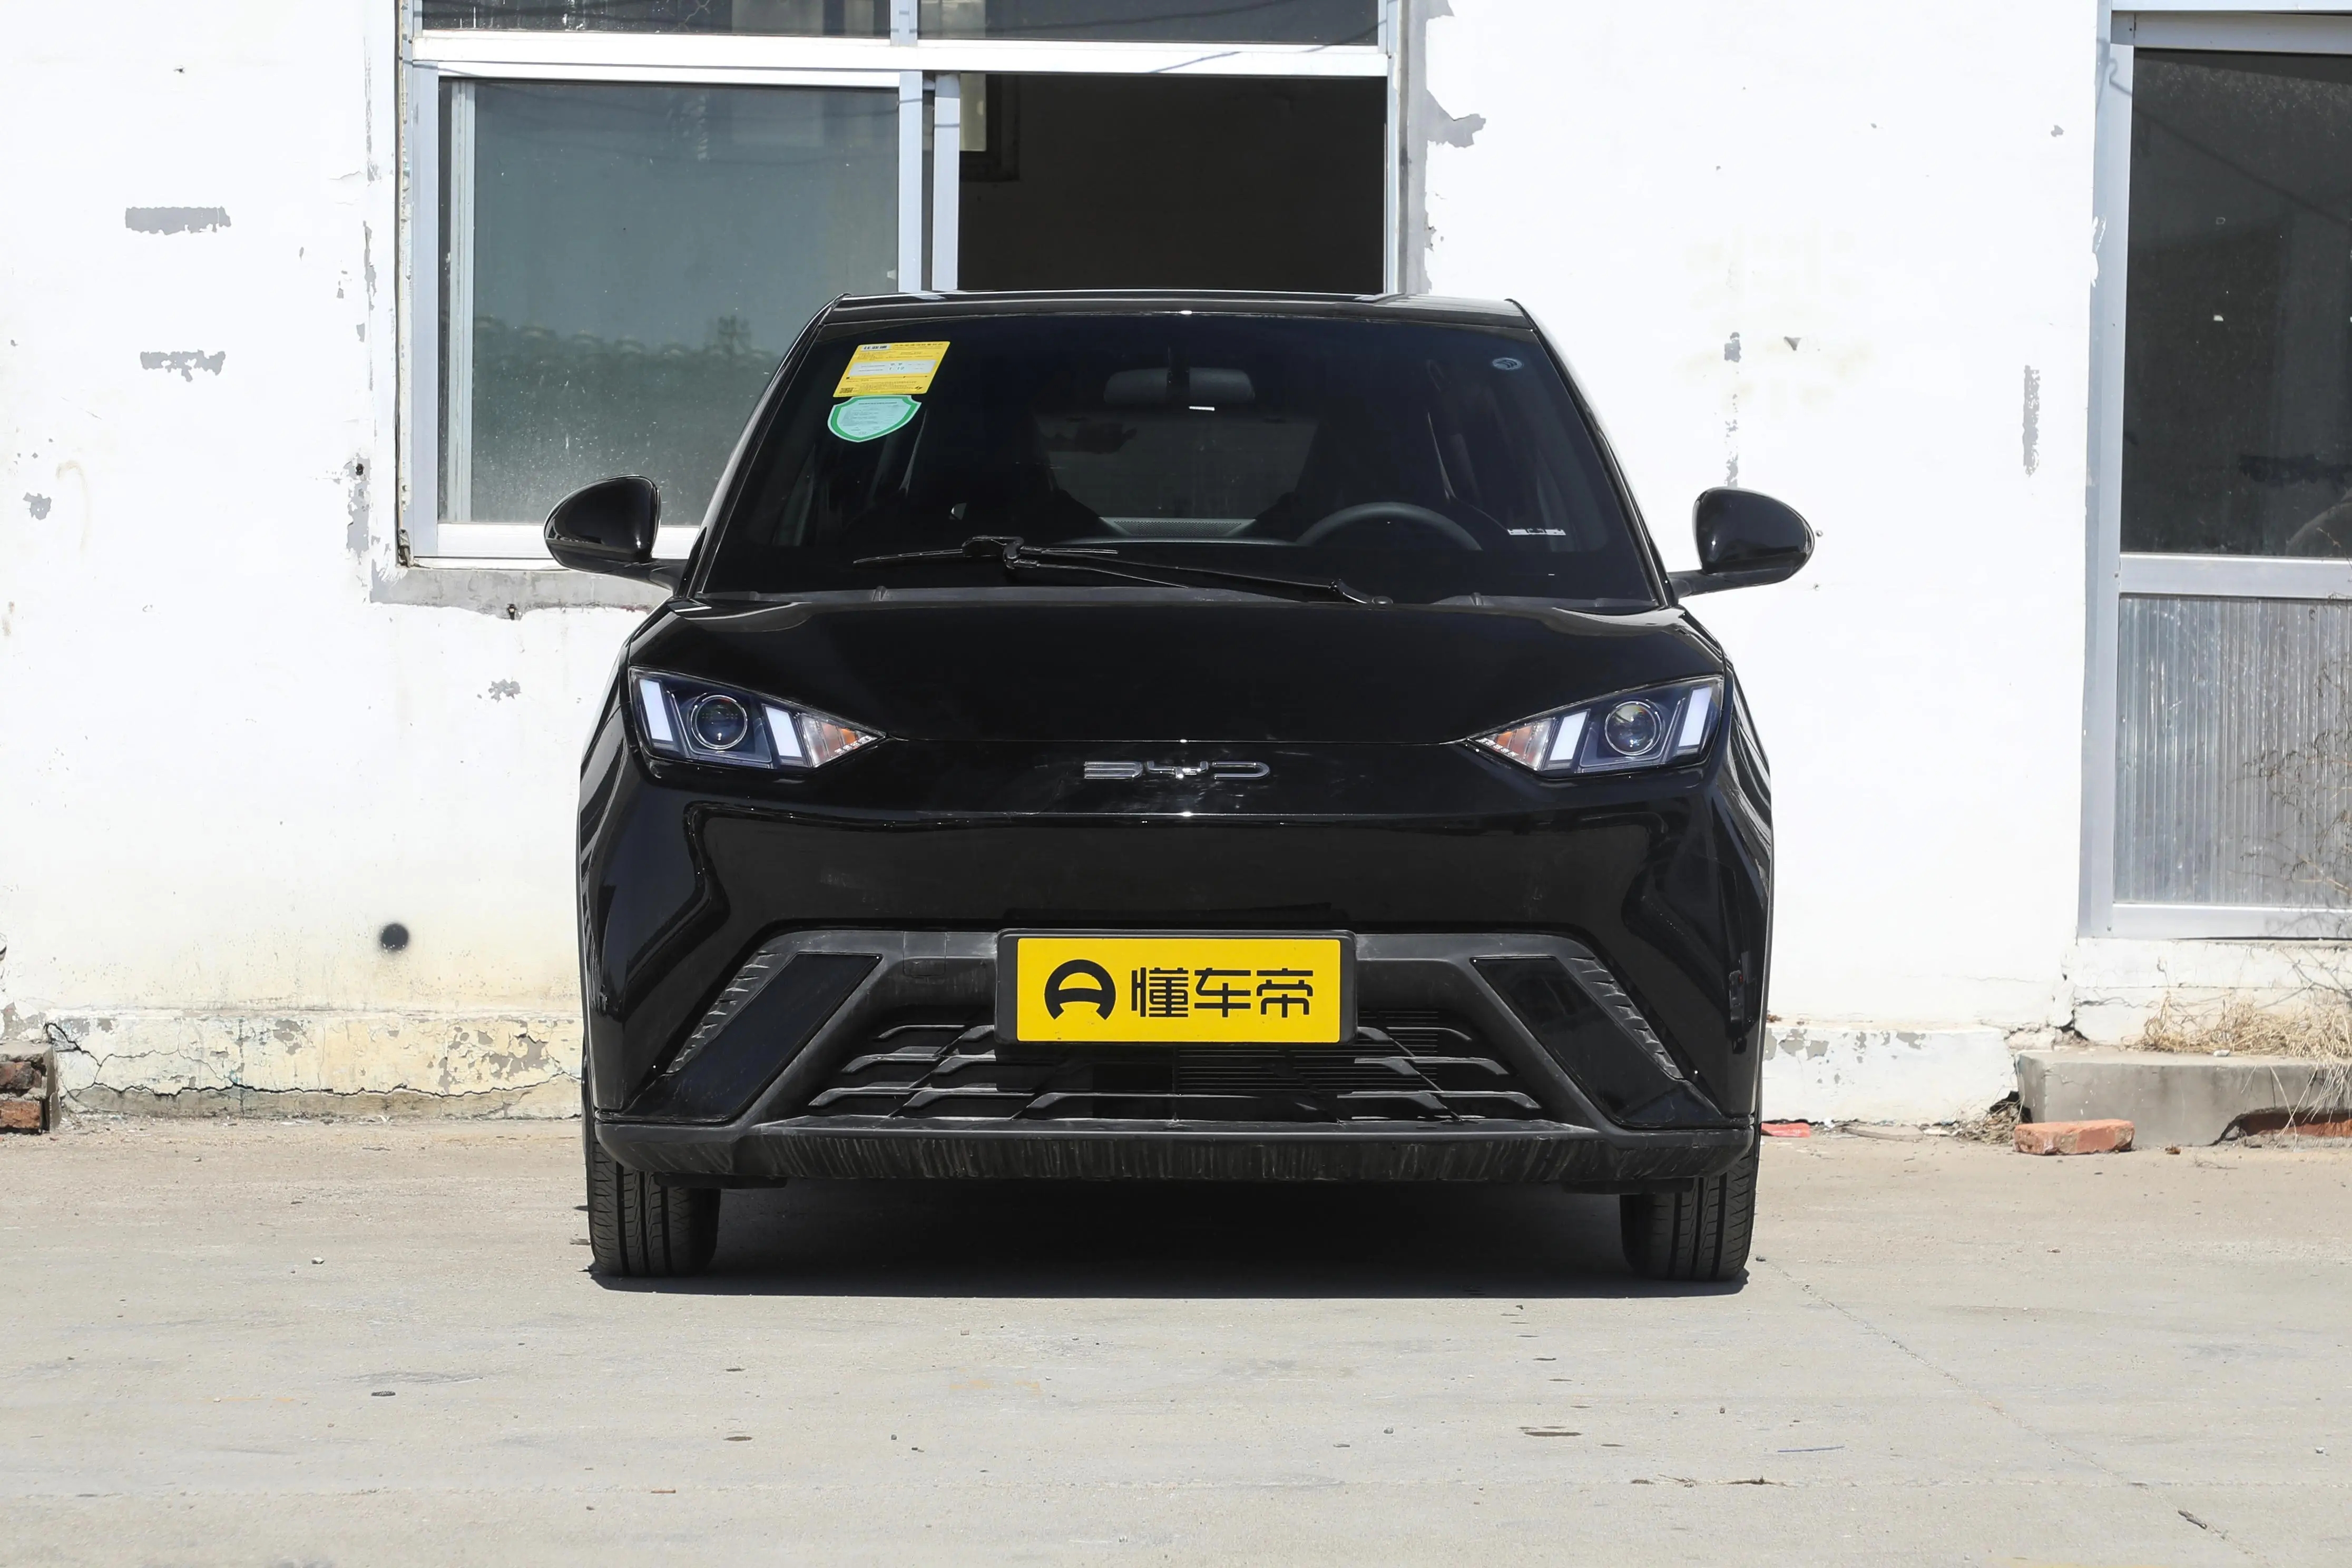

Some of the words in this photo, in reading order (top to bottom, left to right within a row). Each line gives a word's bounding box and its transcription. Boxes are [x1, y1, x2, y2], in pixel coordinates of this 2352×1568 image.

[1083, 761, 1270, 780] BYD
[1131, 967, 1314, 1018] 懂车帝
